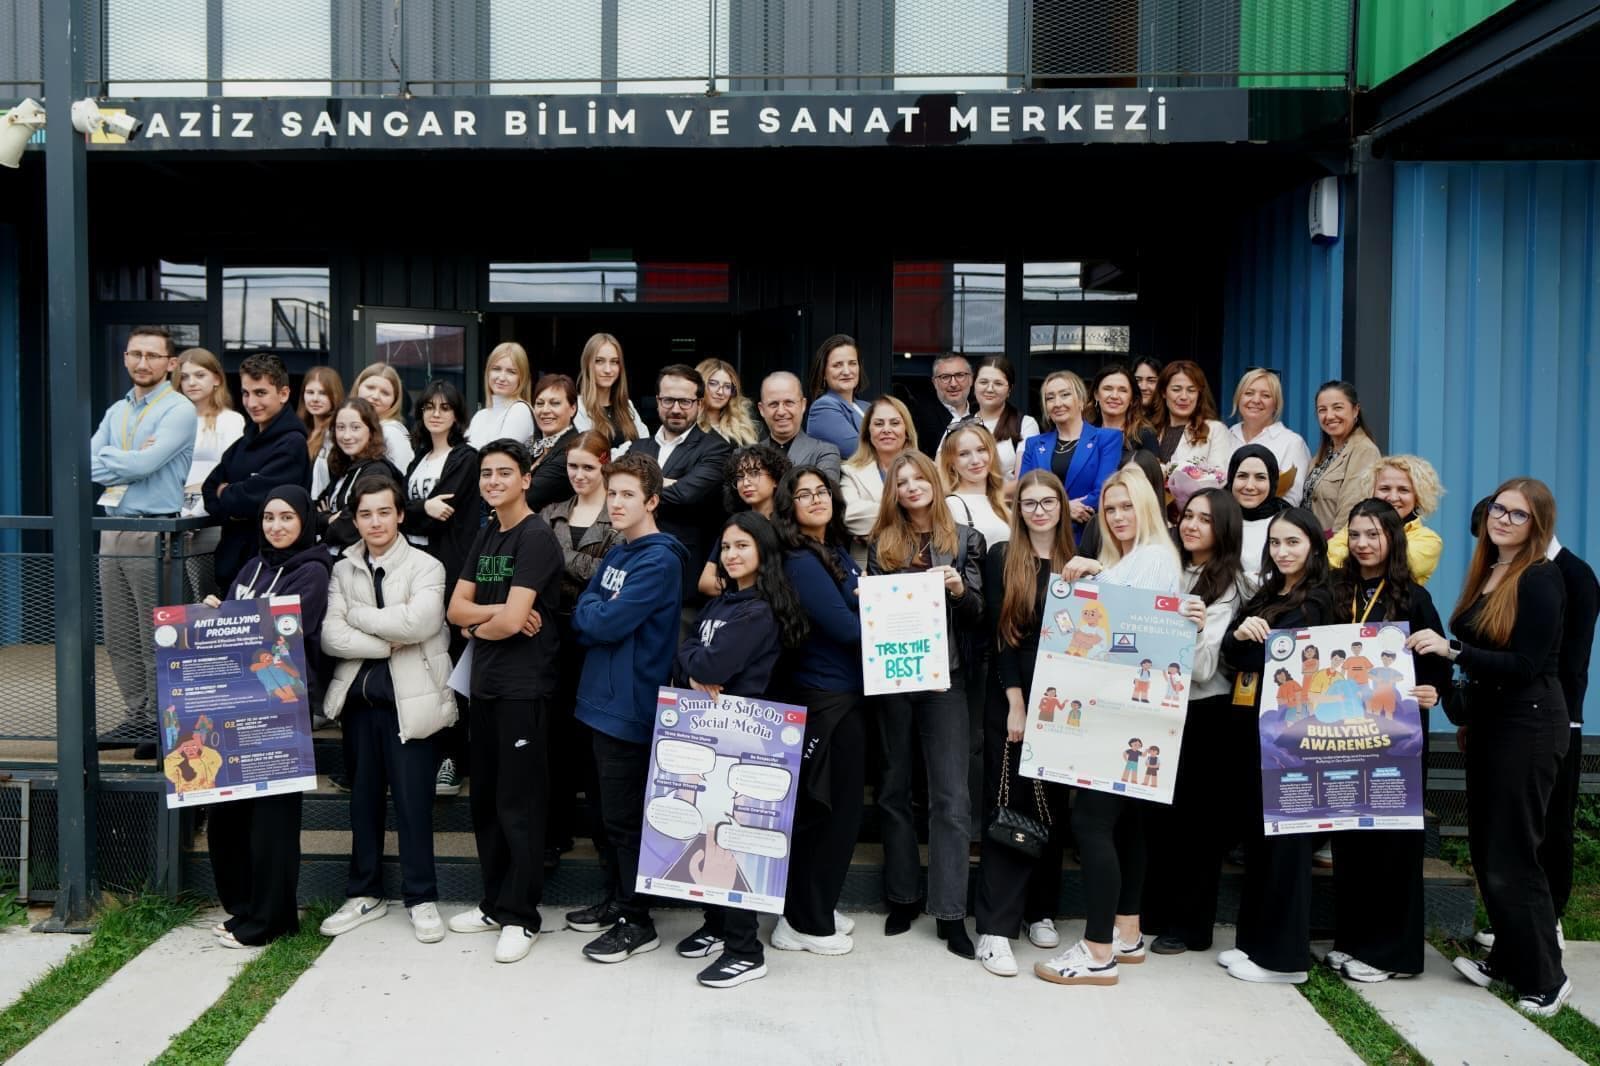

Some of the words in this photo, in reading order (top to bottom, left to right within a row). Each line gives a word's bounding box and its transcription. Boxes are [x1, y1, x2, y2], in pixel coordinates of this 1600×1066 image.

[145, 103, 255, 138] AZİZ
[281, 110, 477, 137] SANCAR
[504, 102, 636, 136] BİLİM
[665, 109, 730, 136] VE
[758, 106, 921, 134] SANAT
[949, 95, 1167, 132] MERKEZİ
[194, 618, 215, 629] ANTI
[216, 614, 261, 627] BULLYING
[205, 625, 251, 638] PROGRAM
[1120, 622, 1193, 639] CYBERBULLYING
[874, 642, 898, 656] TPS
[899, 643, 908, 655] IS
[908, 639, 931, 653] THE
[885, 656, 924, 679] BEST
[722, 699, 732, 711] &
[734, 700, 762, 717] Safe
[764, 708, 783, 724] On
[691, 716, 729, 730] Social
[732, 719, 773, 739] Media
[1307, 722, 1379, 738] BULLYING
[1300, 734, 1391, 751] AWARENESS
